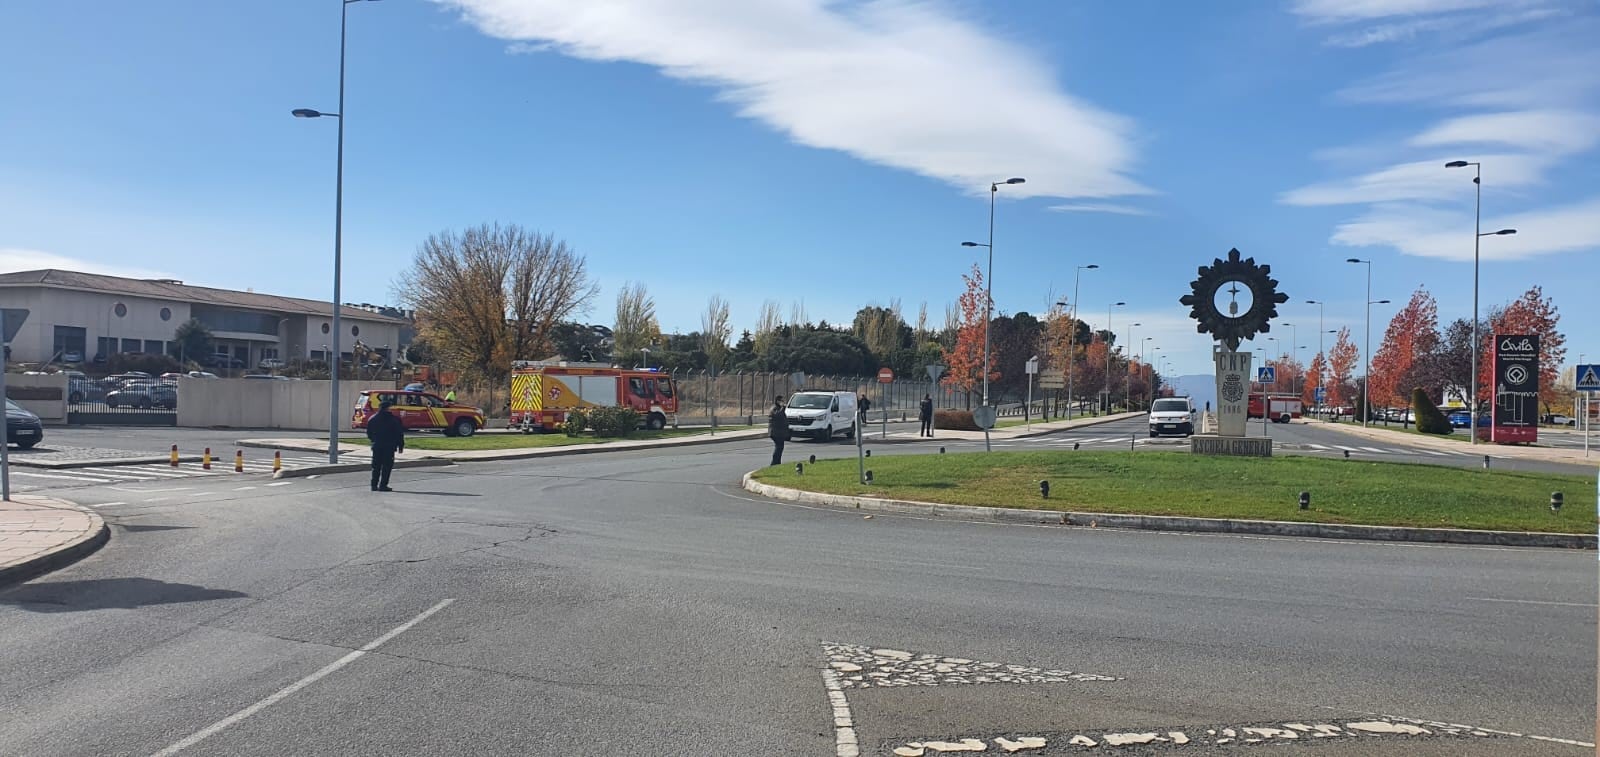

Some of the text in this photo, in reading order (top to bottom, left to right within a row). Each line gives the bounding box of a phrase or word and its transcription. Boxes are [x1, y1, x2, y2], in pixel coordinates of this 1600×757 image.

[1501, 338, 1534, 351] Ávila
[1220, 355, 1247, 371] CNP
[1193, 440, 1272, 457] ESCUELA GENERAL
